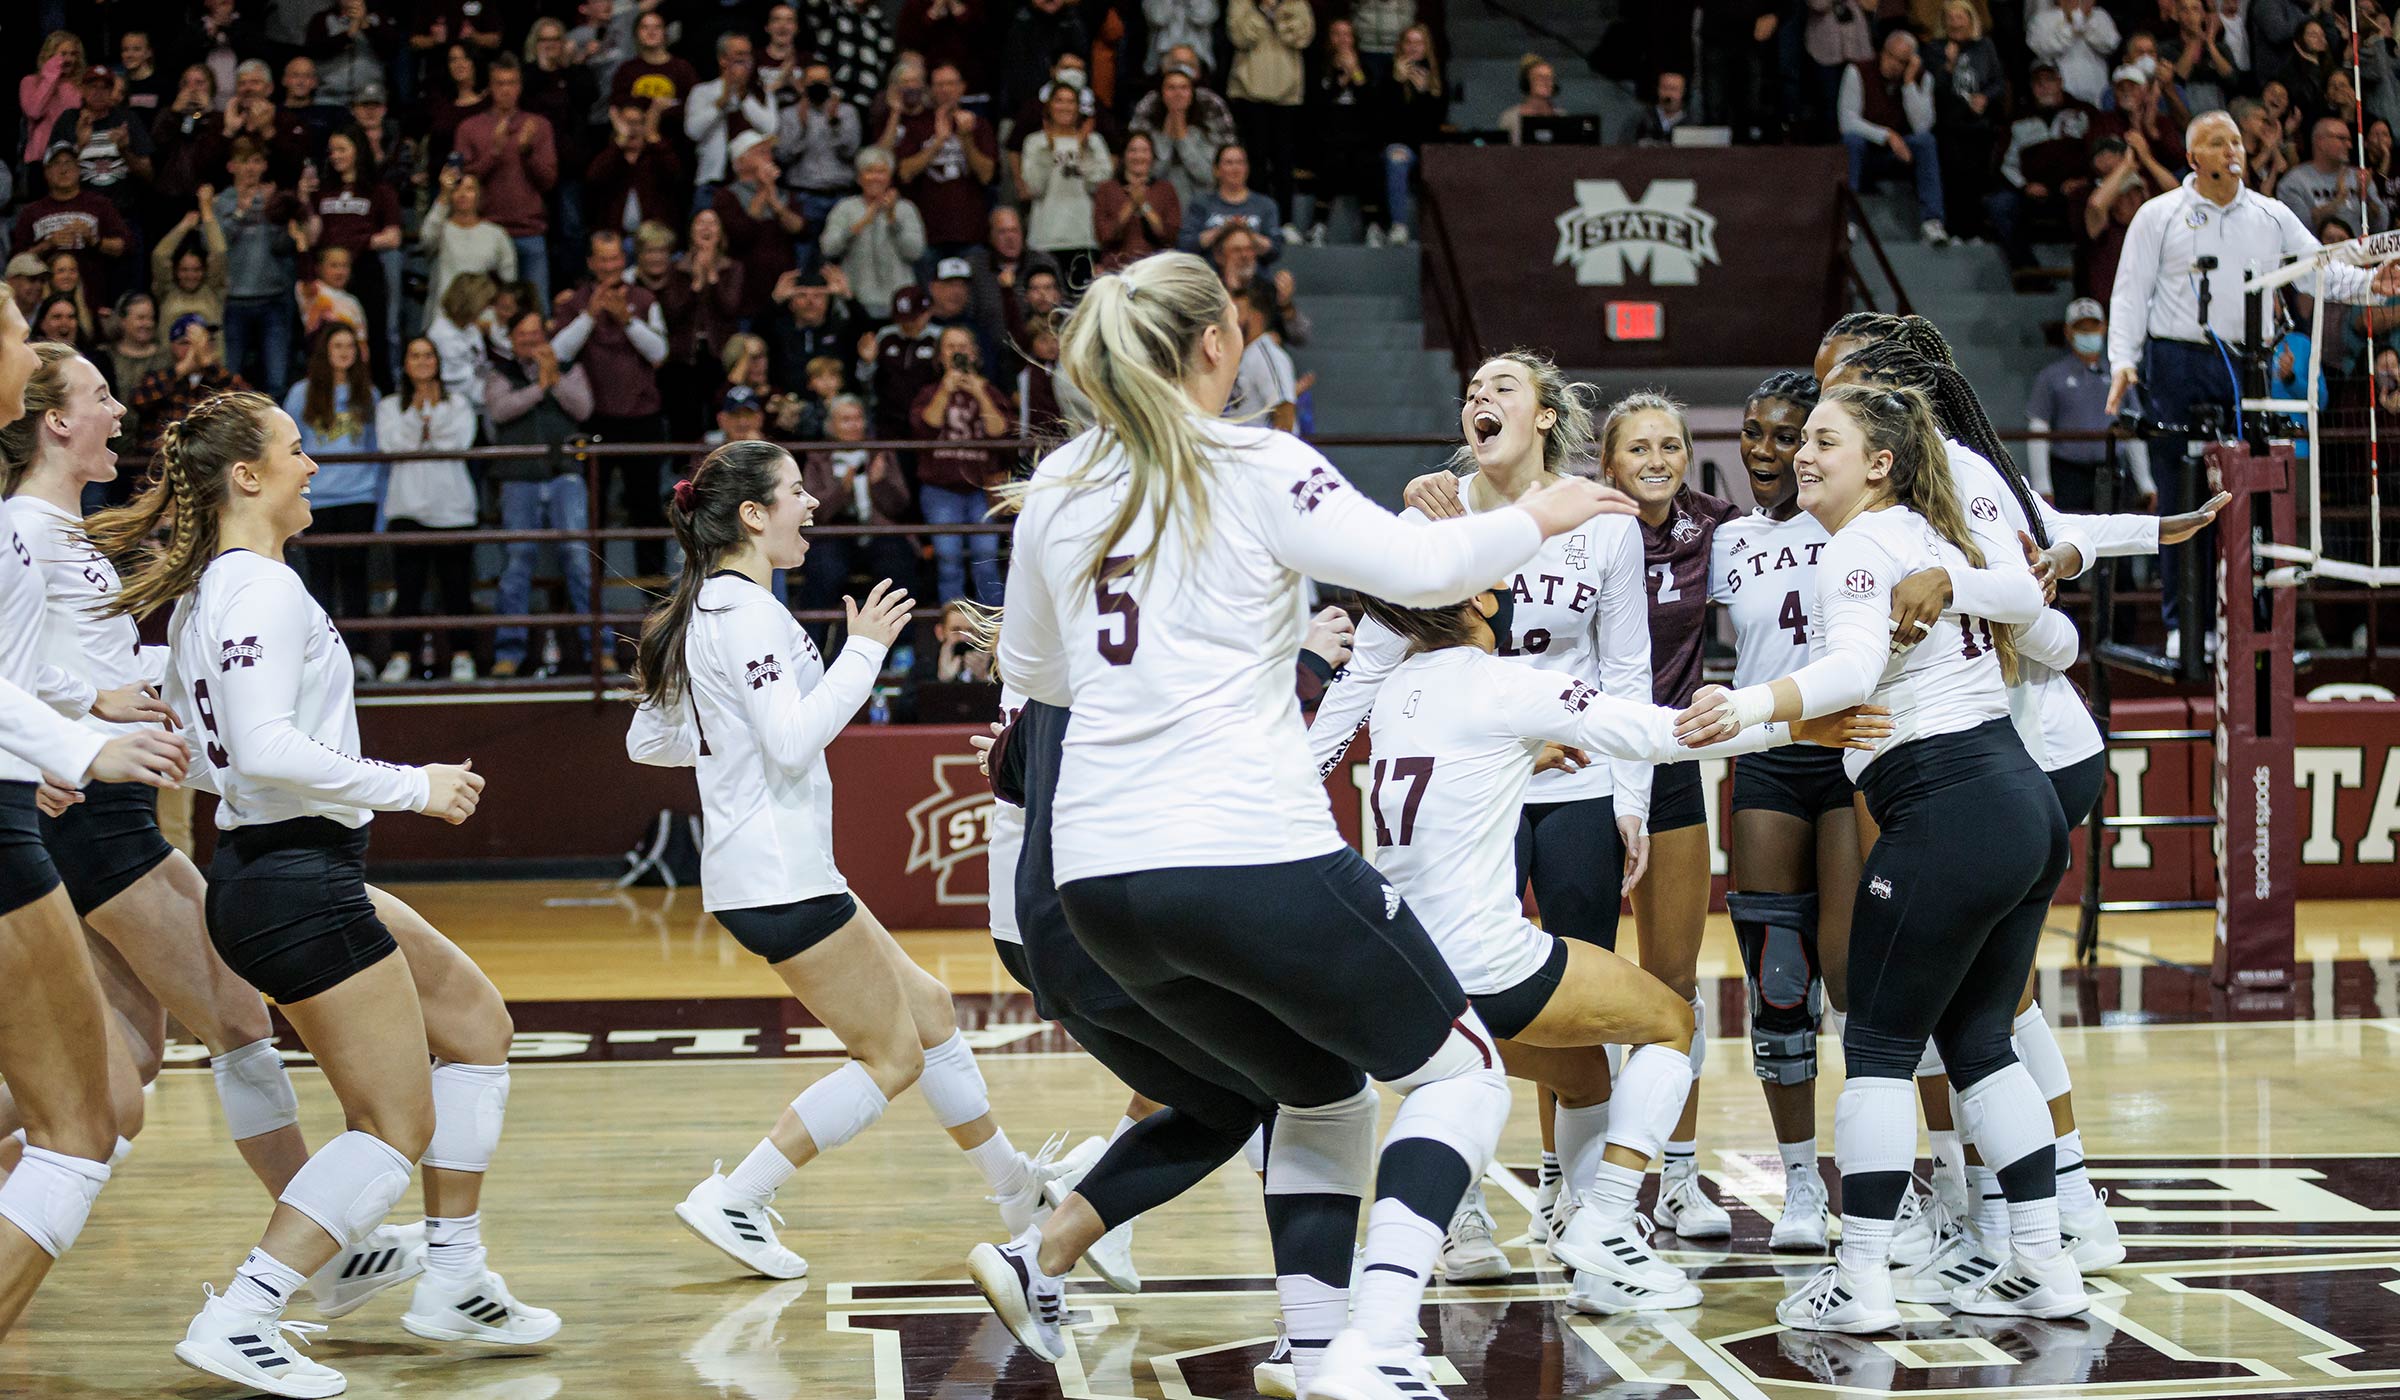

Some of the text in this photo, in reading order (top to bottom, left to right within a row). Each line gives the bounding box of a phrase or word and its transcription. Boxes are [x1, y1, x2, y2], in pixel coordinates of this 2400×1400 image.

[1584, 213, 1688, 246] STATE
[1971, 497, 1998, 522] SEC
[1727, 542, 1826, 593] STAT
[1847, 570, 1874, 592] SEC
[1096, 555, 1139, 666] 5
[1512, 573, 1597, 613] ATE
[1842, 589, 1876, 599] GRADUATE
[1778, 590, 1808, 645] 4
[749, 664, 775, 681] STATE
[1370, 756, 1436, 847] 17
